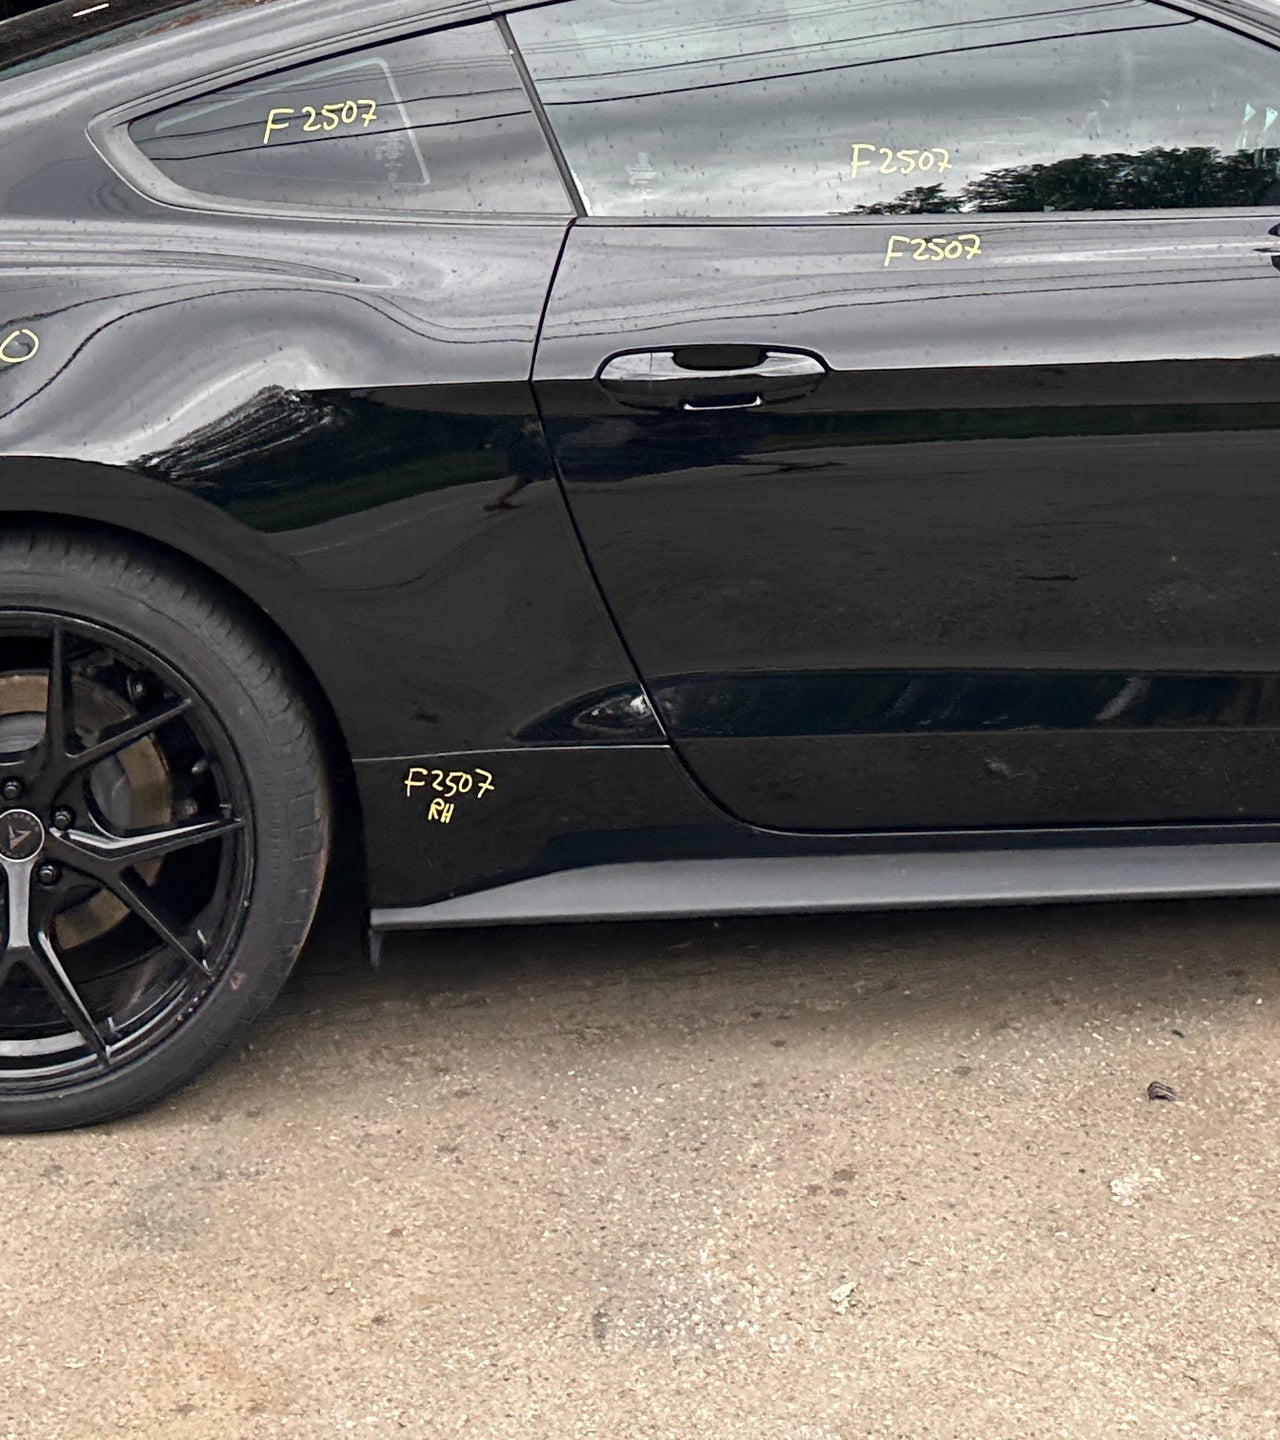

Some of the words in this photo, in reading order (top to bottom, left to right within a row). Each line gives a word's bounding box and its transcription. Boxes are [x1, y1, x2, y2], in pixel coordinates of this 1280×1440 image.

[263, 99, 377, 144] F2507
[850, 143, 952, 178] F2507
[884, 233, 982, 267] F2507
[404, 767, 495, 799] F2507
[427, 797, 455, 824] RH
